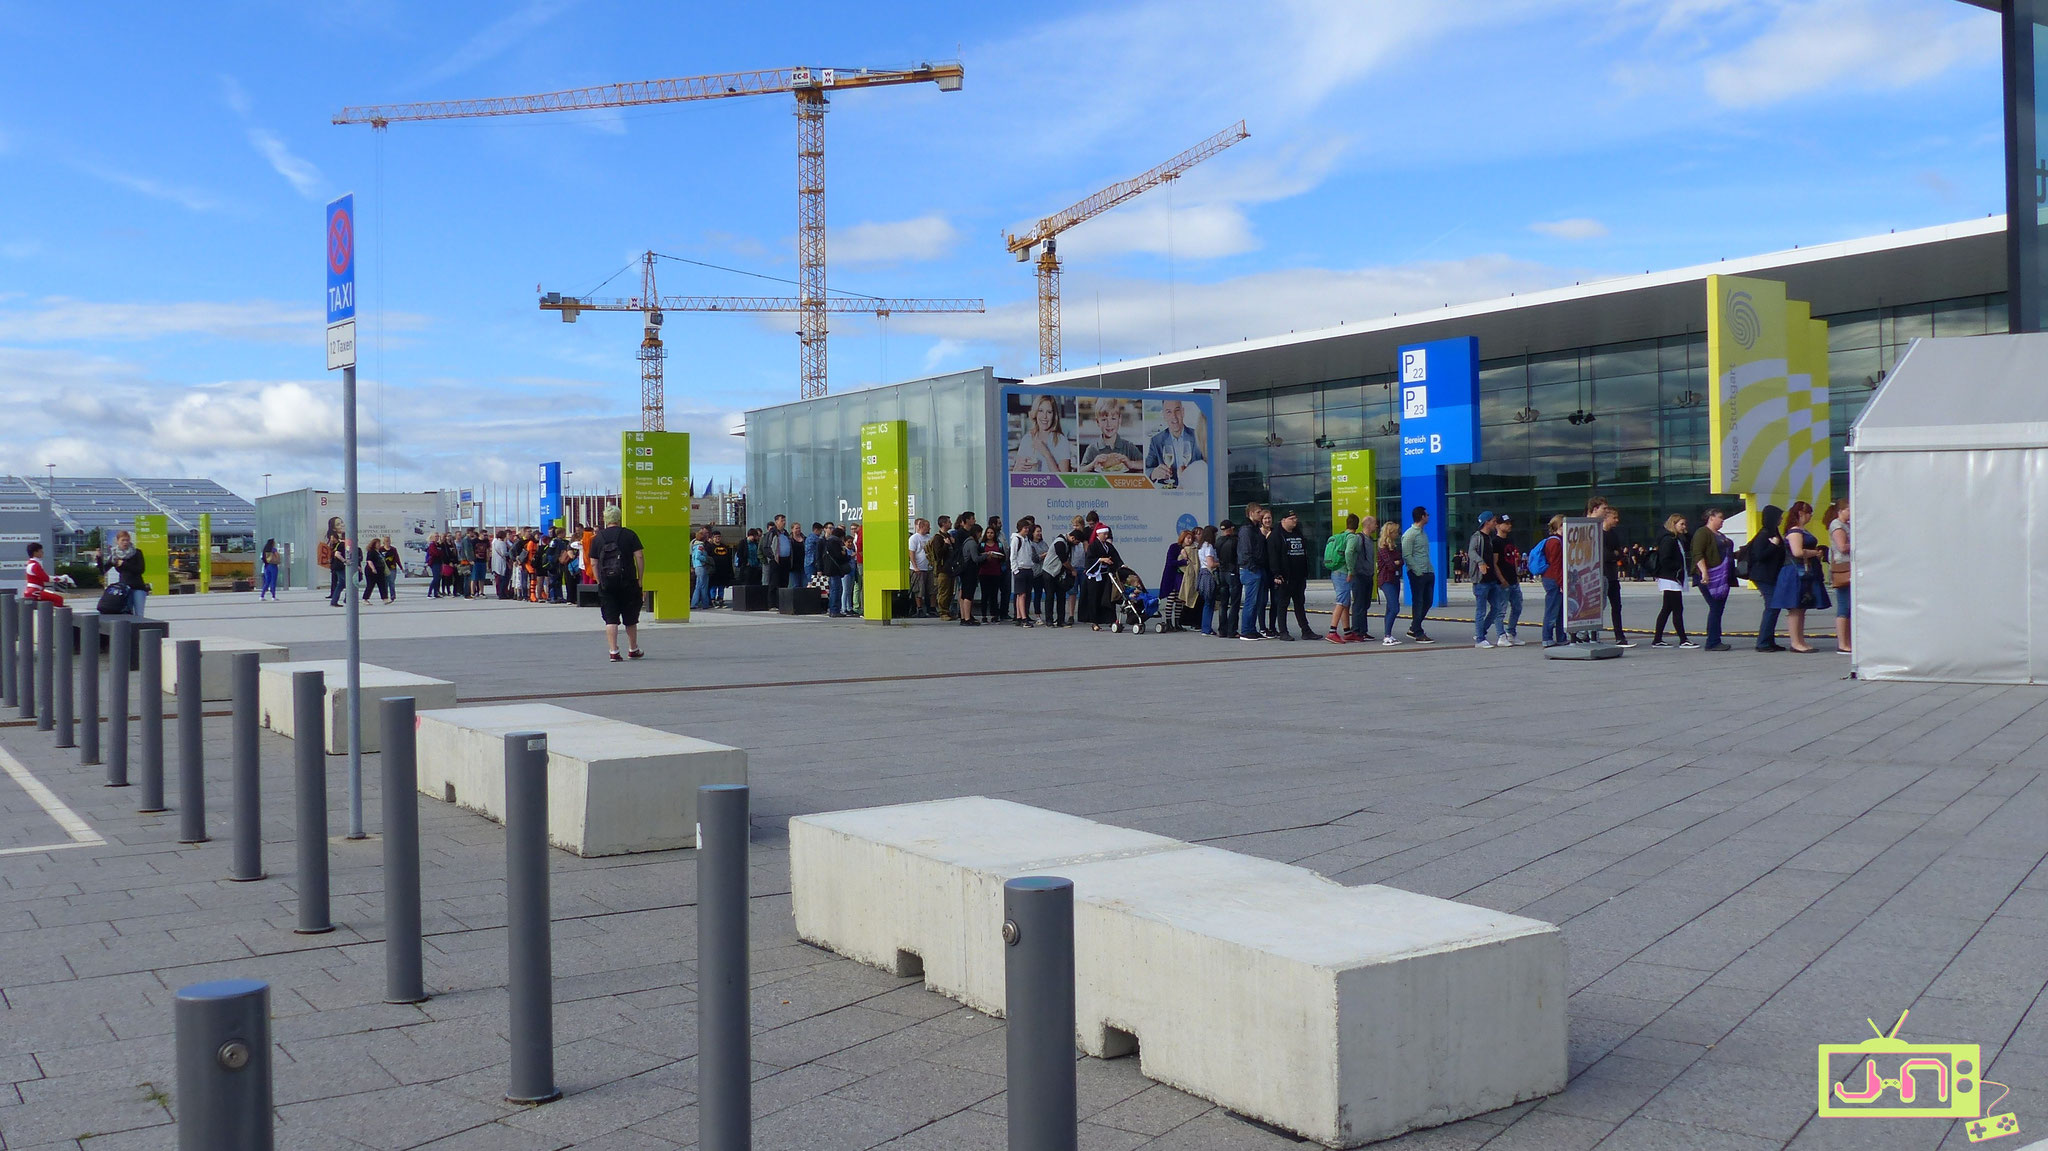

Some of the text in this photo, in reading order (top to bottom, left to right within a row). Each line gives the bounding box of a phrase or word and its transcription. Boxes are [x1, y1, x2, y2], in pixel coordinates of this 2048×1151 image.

[328, 282, 353, 313] TAXI
[330, 339, 353, 355] 12 Taxen
[1405, 354, 1415, 374] P
[1413, 367, 1424, 379] 22
[1406, 390, 1416, 410] P
[1413, 404, 1425, 416] 23
[878, 422, 888, 434] ICS
[1729, 362, 1739, 482] Messe Stuttgart
[1404, 434, 1442, 454] Bereich B
[1404, 446, 1424, 456] Sector
[657, 476, 674, 486] ICS
[1022, 477, 1143, 488] SHOPS FOOD SERVICE
[1047, 498, 1074, 509] Einfach
[649, 505, 654, 515] 1
[1567, 525, 1595, 544] COMIC
